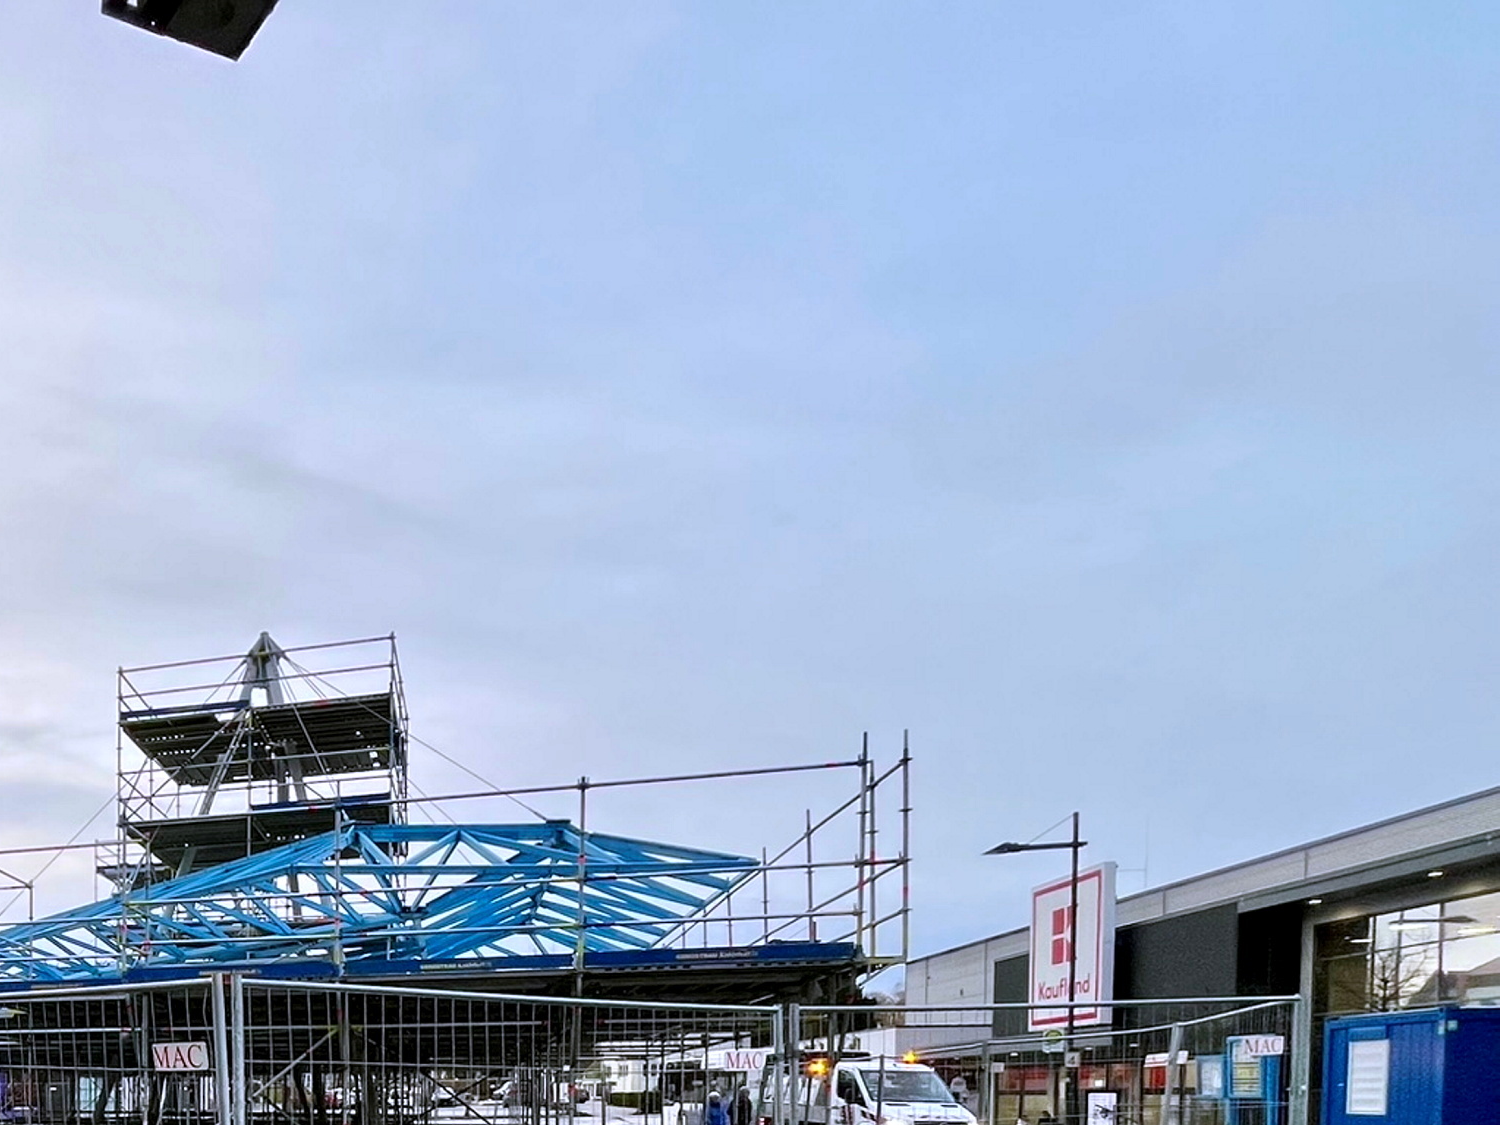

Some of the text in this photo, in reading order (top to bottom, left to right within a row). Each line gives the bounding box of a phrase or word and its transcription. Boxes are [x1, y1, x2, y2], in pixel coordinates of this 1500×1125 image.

[1038, 973, 1090, 1000] Kauflnd
[153, 1044, 204, 1069] MAC
[1244, 1038, 1282, 1054] MAC
[725, 1051, 762, 1070] MAC
